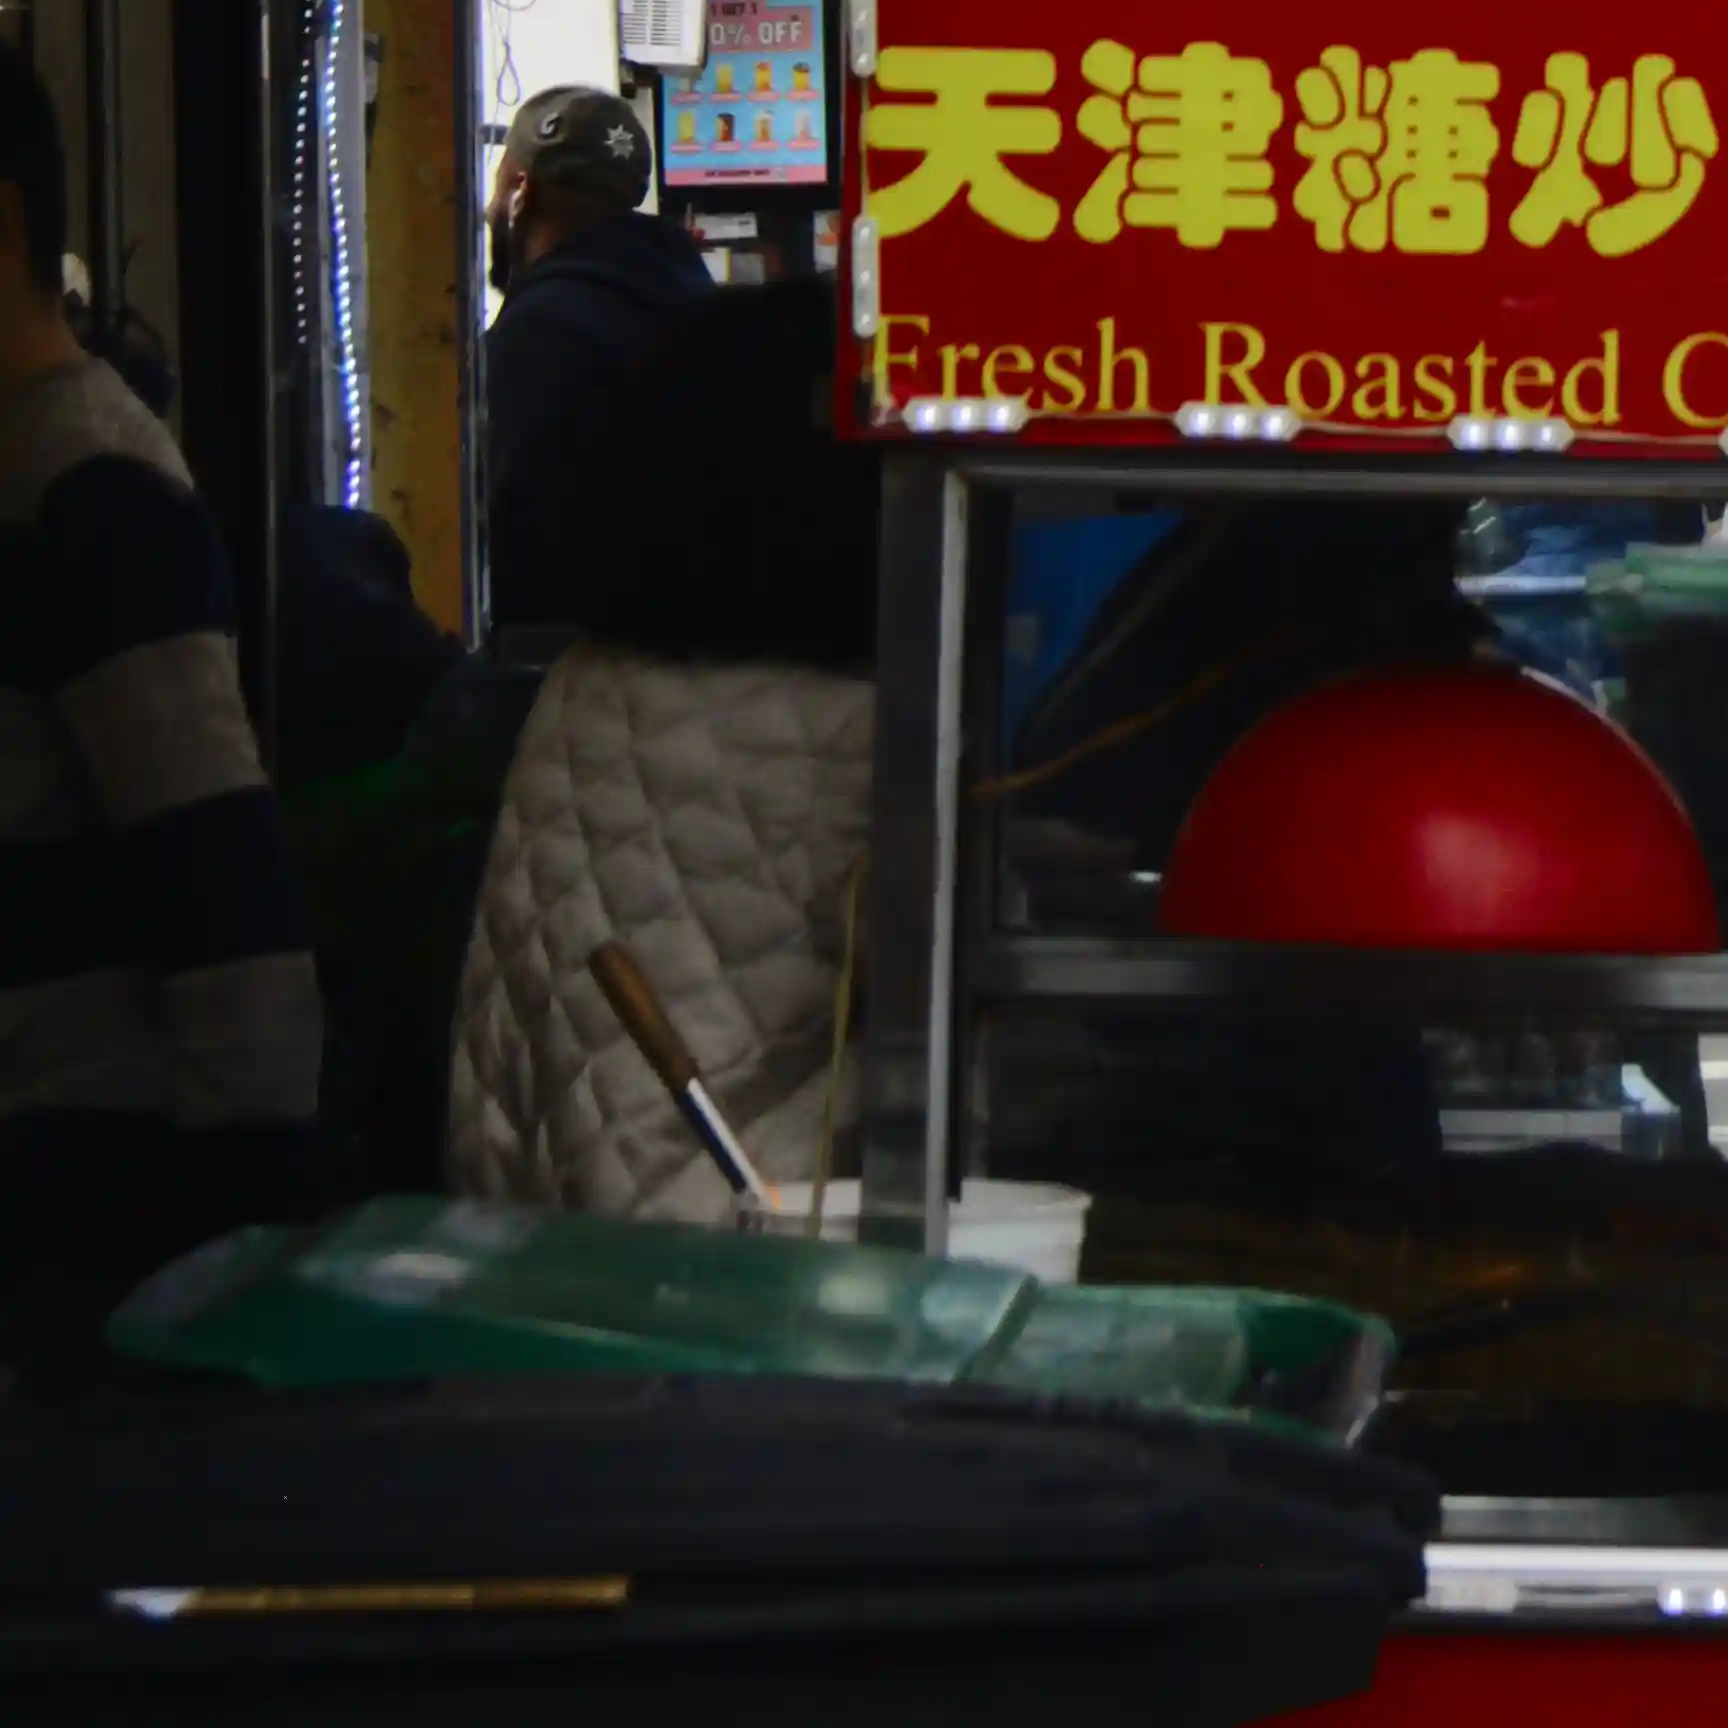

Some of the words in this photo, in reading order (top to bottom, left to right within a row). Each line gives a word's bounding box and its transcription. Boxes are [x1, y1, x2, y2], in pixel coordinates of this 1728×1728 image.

[758, 21, 804, 44] OFF
[872, 315, 1154, 412] Fresh
[1198, 322, 1622, 425] Roasted
